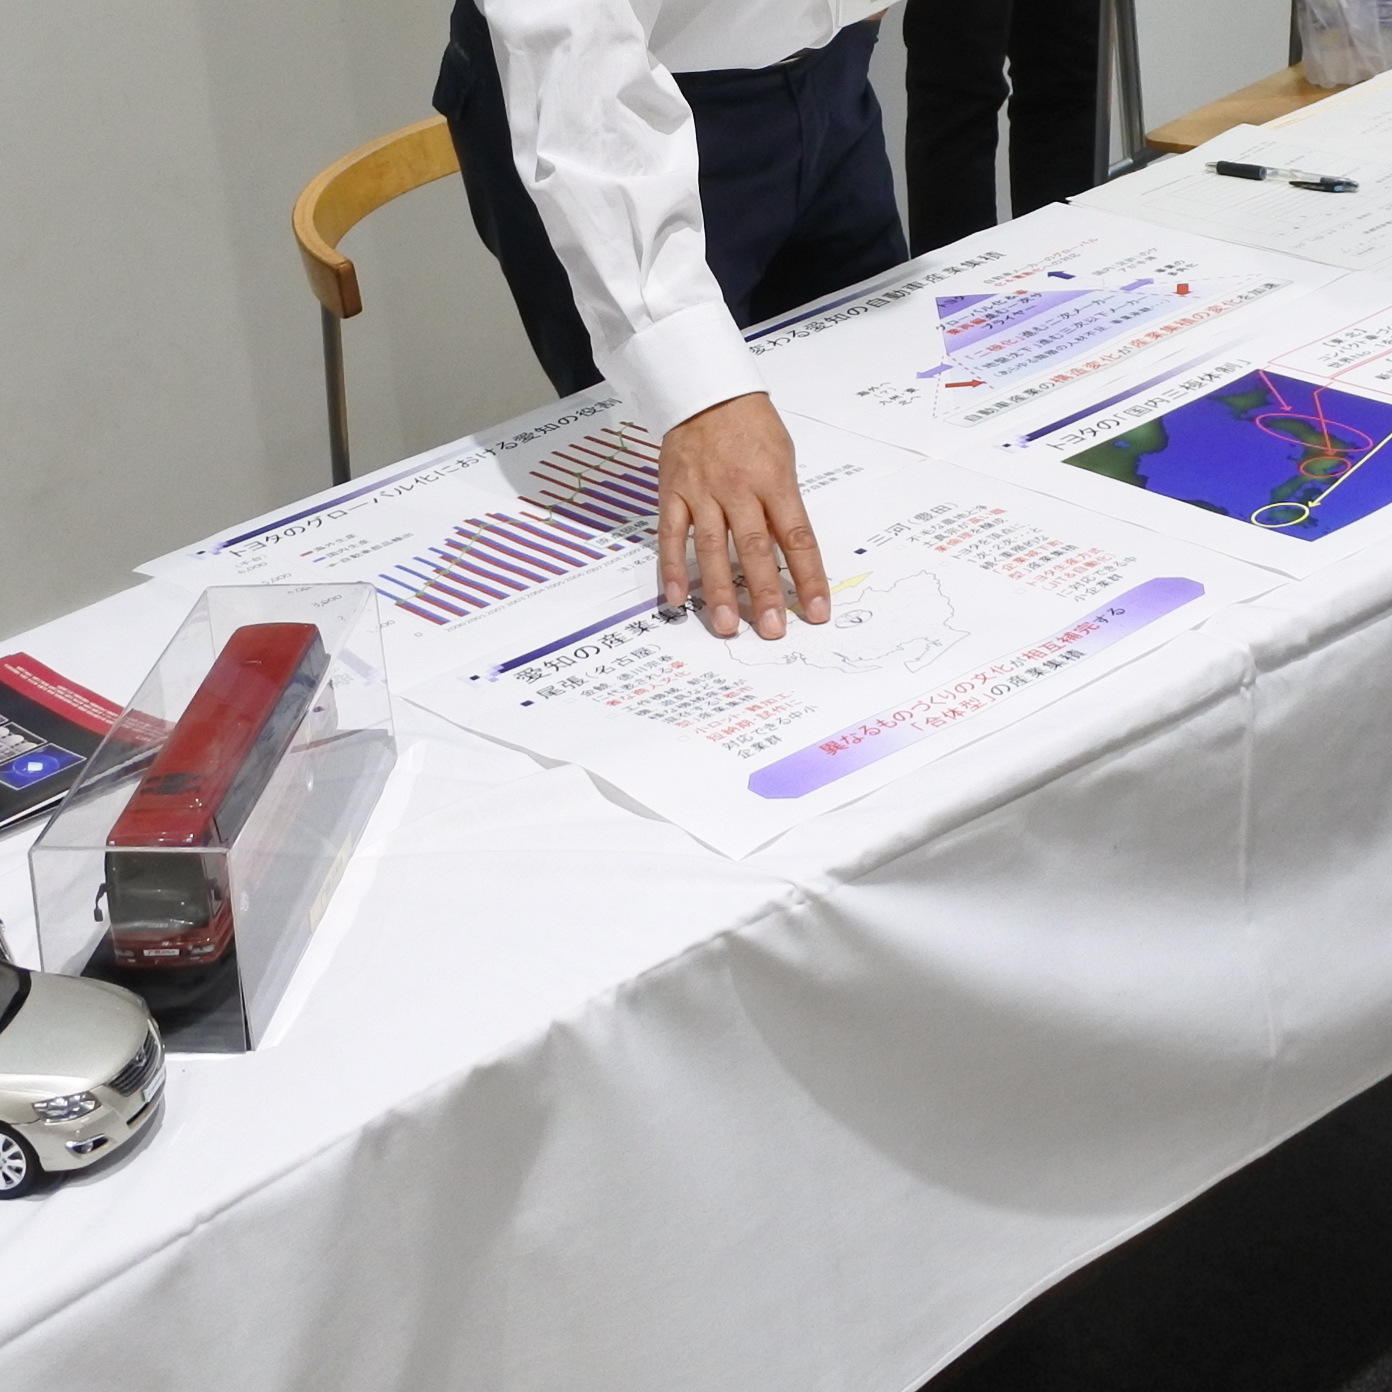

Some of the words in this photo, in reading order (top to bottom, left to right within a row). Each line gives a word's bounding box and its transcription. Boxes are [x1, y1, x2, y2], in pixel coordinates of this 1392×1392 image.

[229, 397, 624, 558] トヨタのグローバル化における愛知の役割
[817, 604, 1128, 756] 異なるものづくりの文化が相互補完する
[907, 647, 1087, 735] 「合体型」の産業集積
